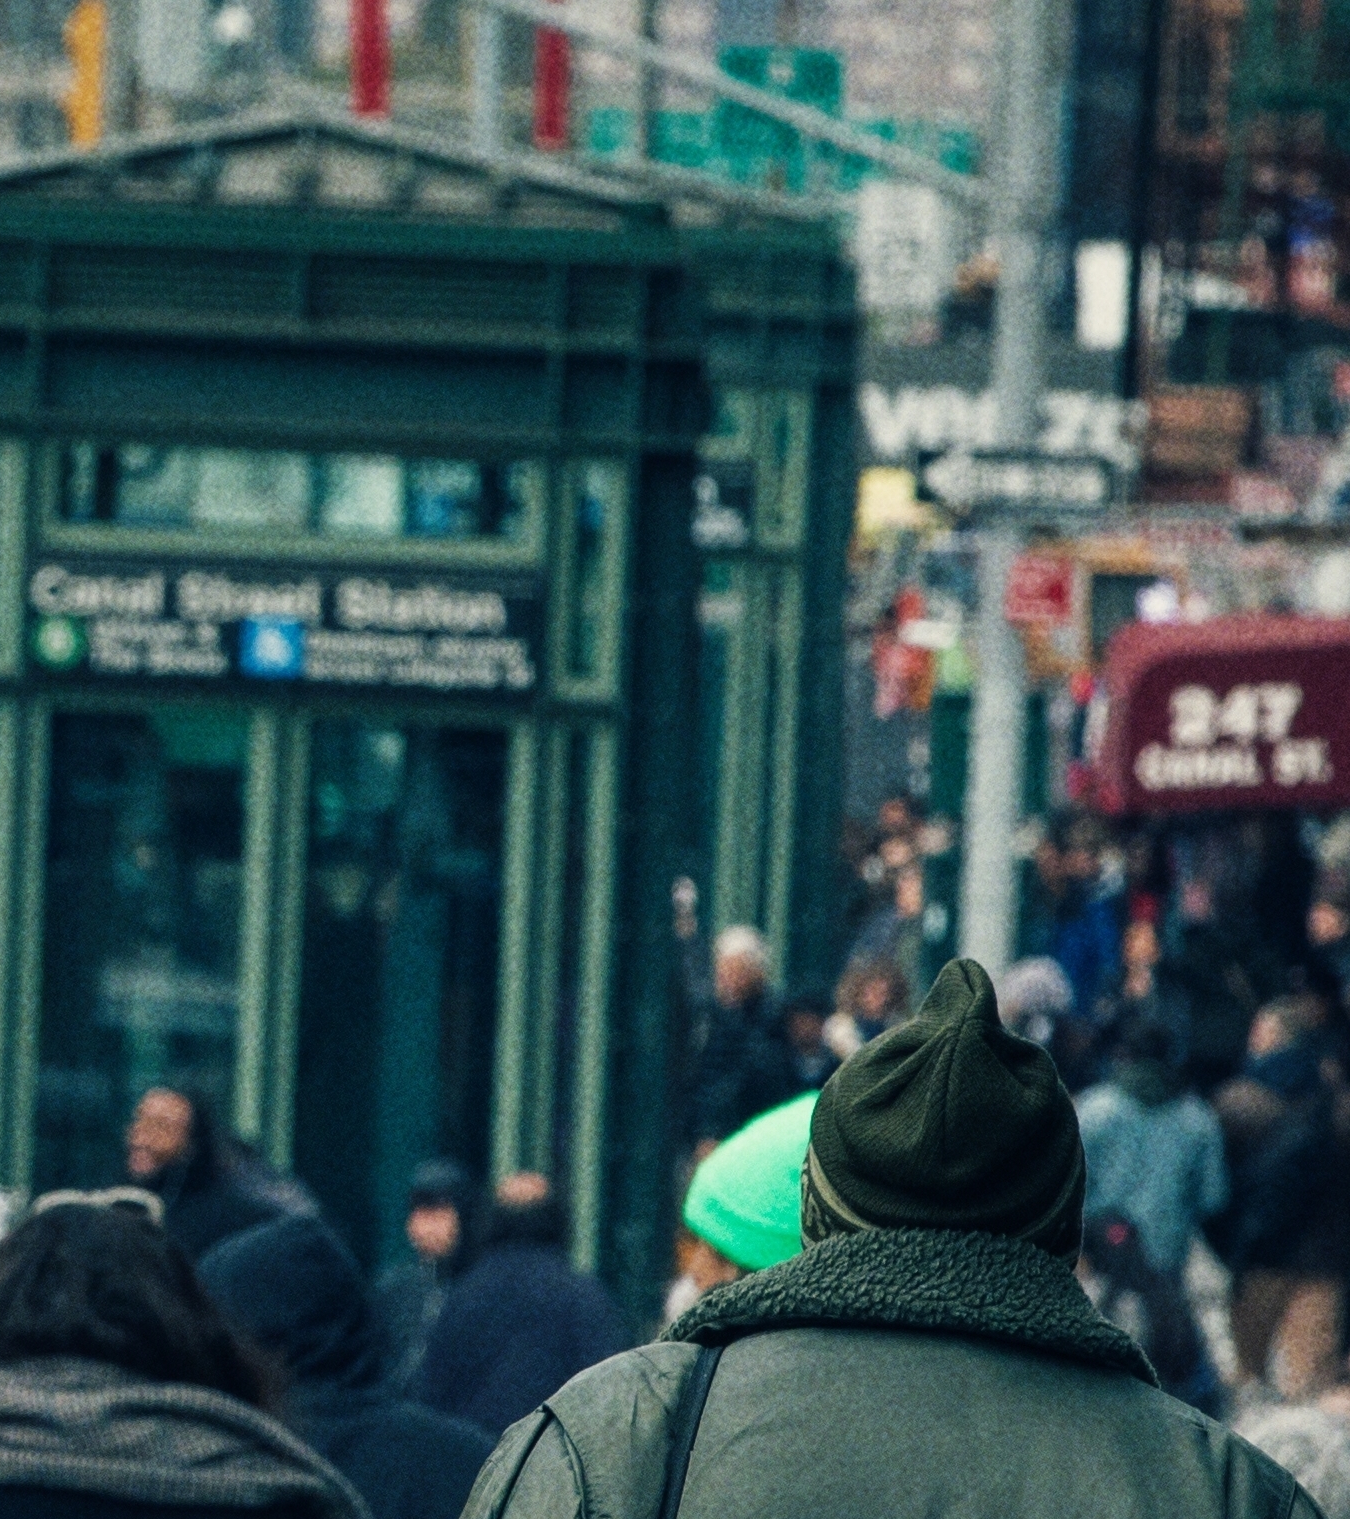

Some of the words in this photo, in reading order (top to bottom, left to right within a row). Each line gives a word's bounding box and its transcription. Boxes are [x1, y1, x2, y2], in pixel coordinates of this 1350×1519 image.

[31, 564, 164, 614] Canal
[177, 572, 320, 624] Street
[335, 578, 506, 630] Station
[1170, 683, 1303, 746] 247
[1134, 743, 1262, 791] CANAL
